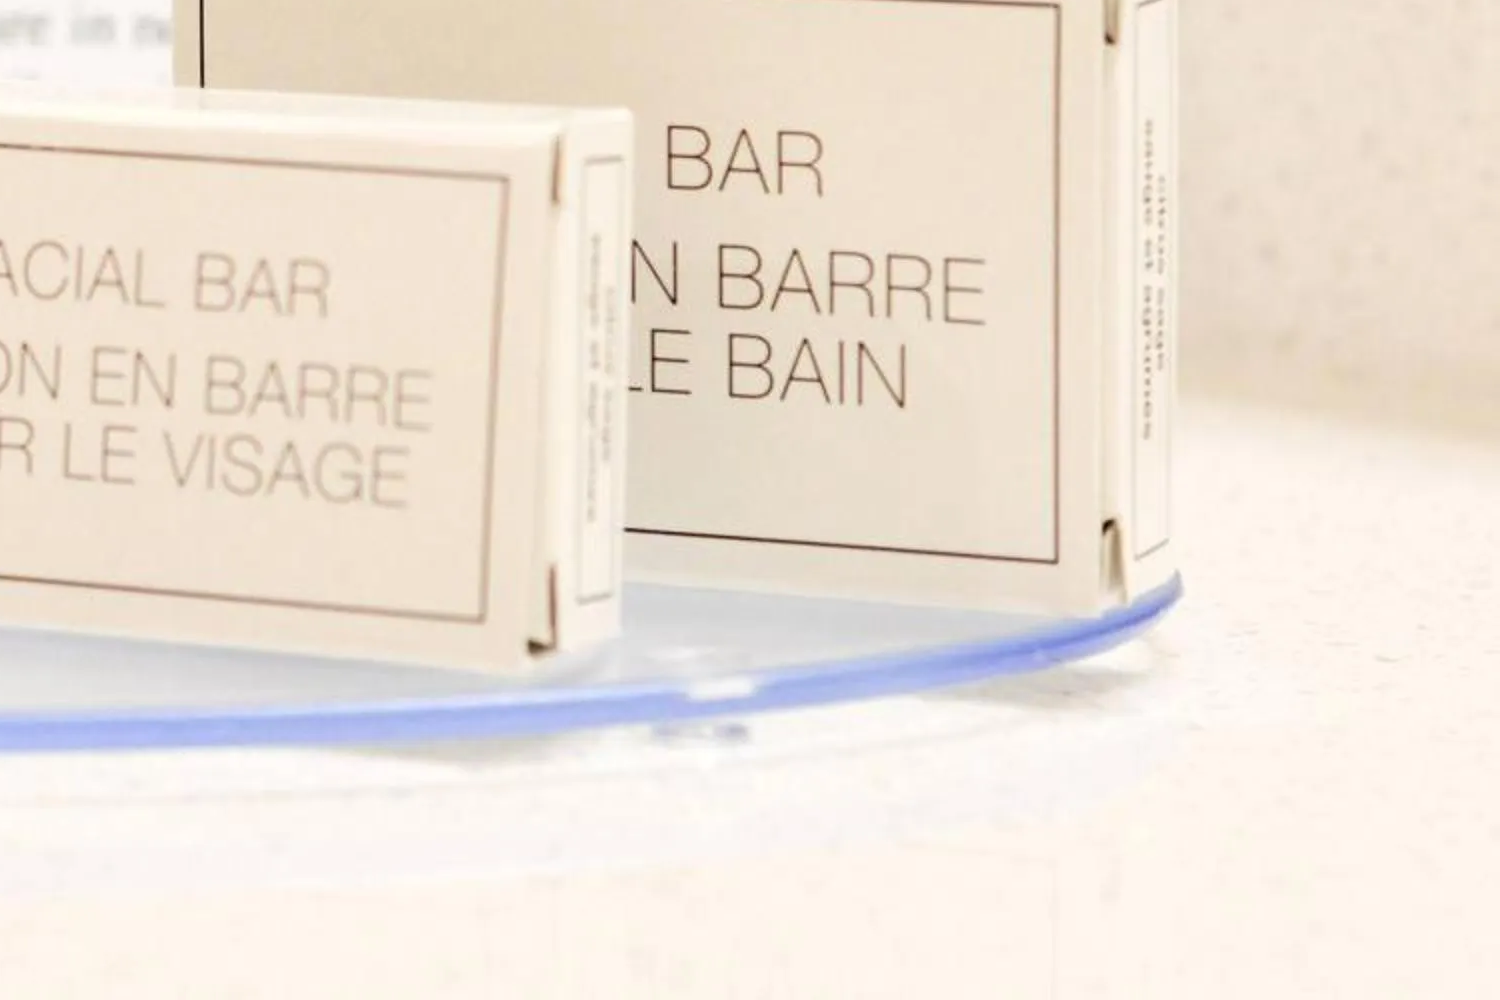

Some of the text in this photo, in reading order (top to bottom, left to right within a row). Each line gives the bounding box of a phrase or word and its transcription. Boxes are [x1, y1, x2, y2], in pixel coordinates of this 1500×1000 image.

[666, 124, 824, 198] BAR
[193, 251, 332, 318] BAR
[630, 238, 987, 327] N BARRE
[89, 345, 178, 409] EN
[203, 354, 435, 433] BARRE
[728, 332, 907, 410] BAIN
[61, 422, 138, 487] LE
[163, 429, 412, 508] VISAGE
